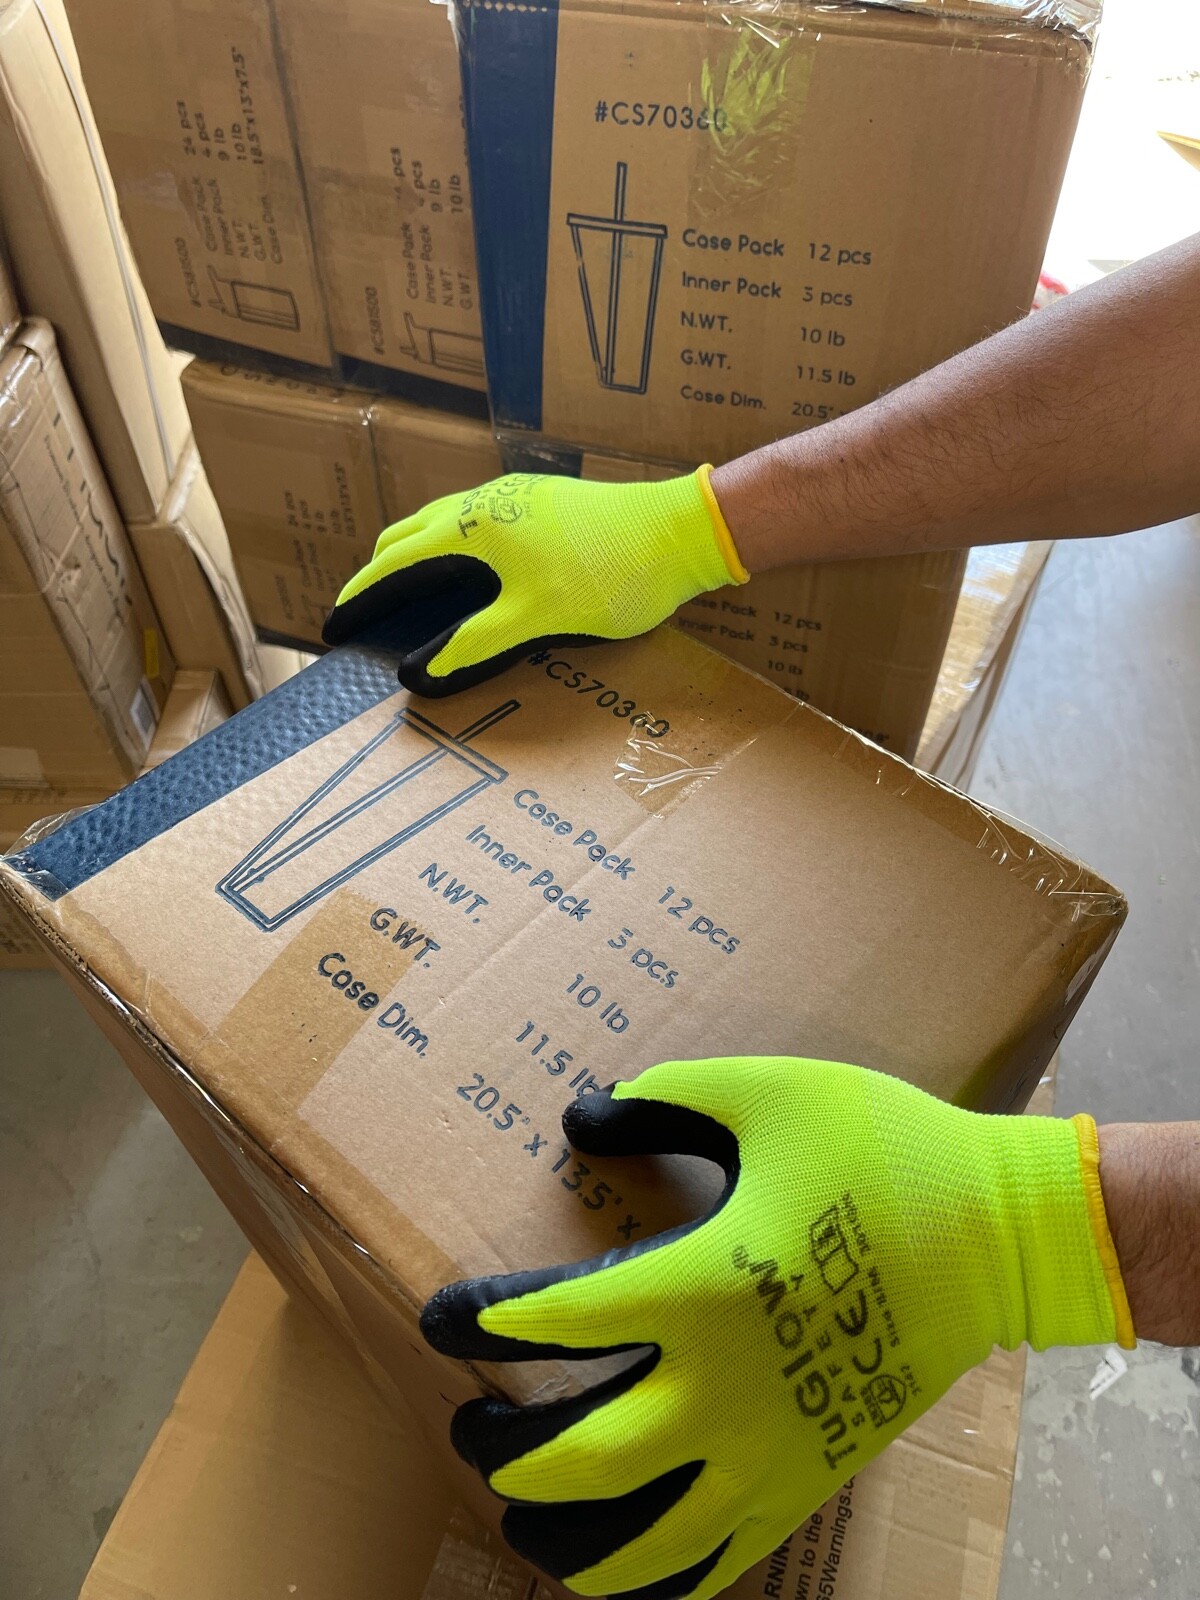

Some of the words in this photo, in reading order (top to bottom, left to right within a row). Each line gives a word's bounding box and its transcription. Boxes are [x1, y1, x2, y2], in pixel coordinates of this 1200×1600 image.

[176, 100, 193, 130] pcs
[194, 112, 210, 142] pcs
[594, 100, 729, 133] #CS70360
[213, 127, 226, 144] lb
[230, 122, 242, 140] lb
[233, 142, 247, 161] 10
[389, 146, 406, 178] pcs
[411, 160, 427, 190] pcs
[427, 178, 441, 196] lb
[447, 174, 463, 192] lb
[430, 201, 443, 213] 9
[449, 194, 464, 214] 10
[400, 222, 416, 260] Pack
[418, 223, 434, 262] Pack
[682, 227, 733, 252] Case
[737, 234, 785, 257] Pack
[808, 242, 832, 263] 12
[836, 247, 873, 267] pcs
[405, 260, 420, 300] Case
[424, 263, 437, 304] Inner
[681, 271, 731, 293] Inner
[736, 277, 782, 299] Pack
[802, 286, 814, 303] 3
[819, 289, 854, 308] pcs
[680, 310, 734, 334] N.WT.
[800, 327, 822, 346] 10
[827, 330, 846, 348] lb
[680, 348, 732, 371] G.WT.
[796, 365, 833, 385] 11.5
[838, 369, 857, 387] lb
[680, 384, 725, 405] Case
[729, 391, 768, 411] Dim.
[690, 599, 718, 611] ase
[720, 601, 758, 618] Pack
[773, 611, 793, 625] 12
[796, 618, 822, 632] pcs
[677, 616, 717, 634] Inner
[719, 624, 756, 641] Pack
[768, 635, 779, 648] 3
[782, 640, 809, 653] pcs
[767, 660, 786, 673] 10
[527, 650, 671, 739] #CS70360
[513, 789, 573, 837] Case
[572, 829, 636, 881] Pack
[465, 824, 531, 876] Inner
[528, 869, 593, 923] Pack
[418, 862, 490, 924] N.WT.
[656, 885, 694, 919] 12
[688, 915, 741, 955] pcs
[369, 906, 442, 968] G.WT.
[607, 927, 634, 950] 3
[630, 948, 682, 988] pcs
[317, 952, 381, 1012] Case
[377, 1001, 430, 1059] Dim.
[565, 973, 602, 1009] 10
[599, 1001, 631, 1034] lb
[514, 1020, 573, 1077] 11.5
[568, 1067, 601, 1098] lb
[523, 1132, 549, 1157] x
[835, 1289, 883, 1375] CE
[790, 1274, 866, 1428] SAFETY
[804, 1512, 824, 1543] the
[799, 1548, 817, 1568] to
